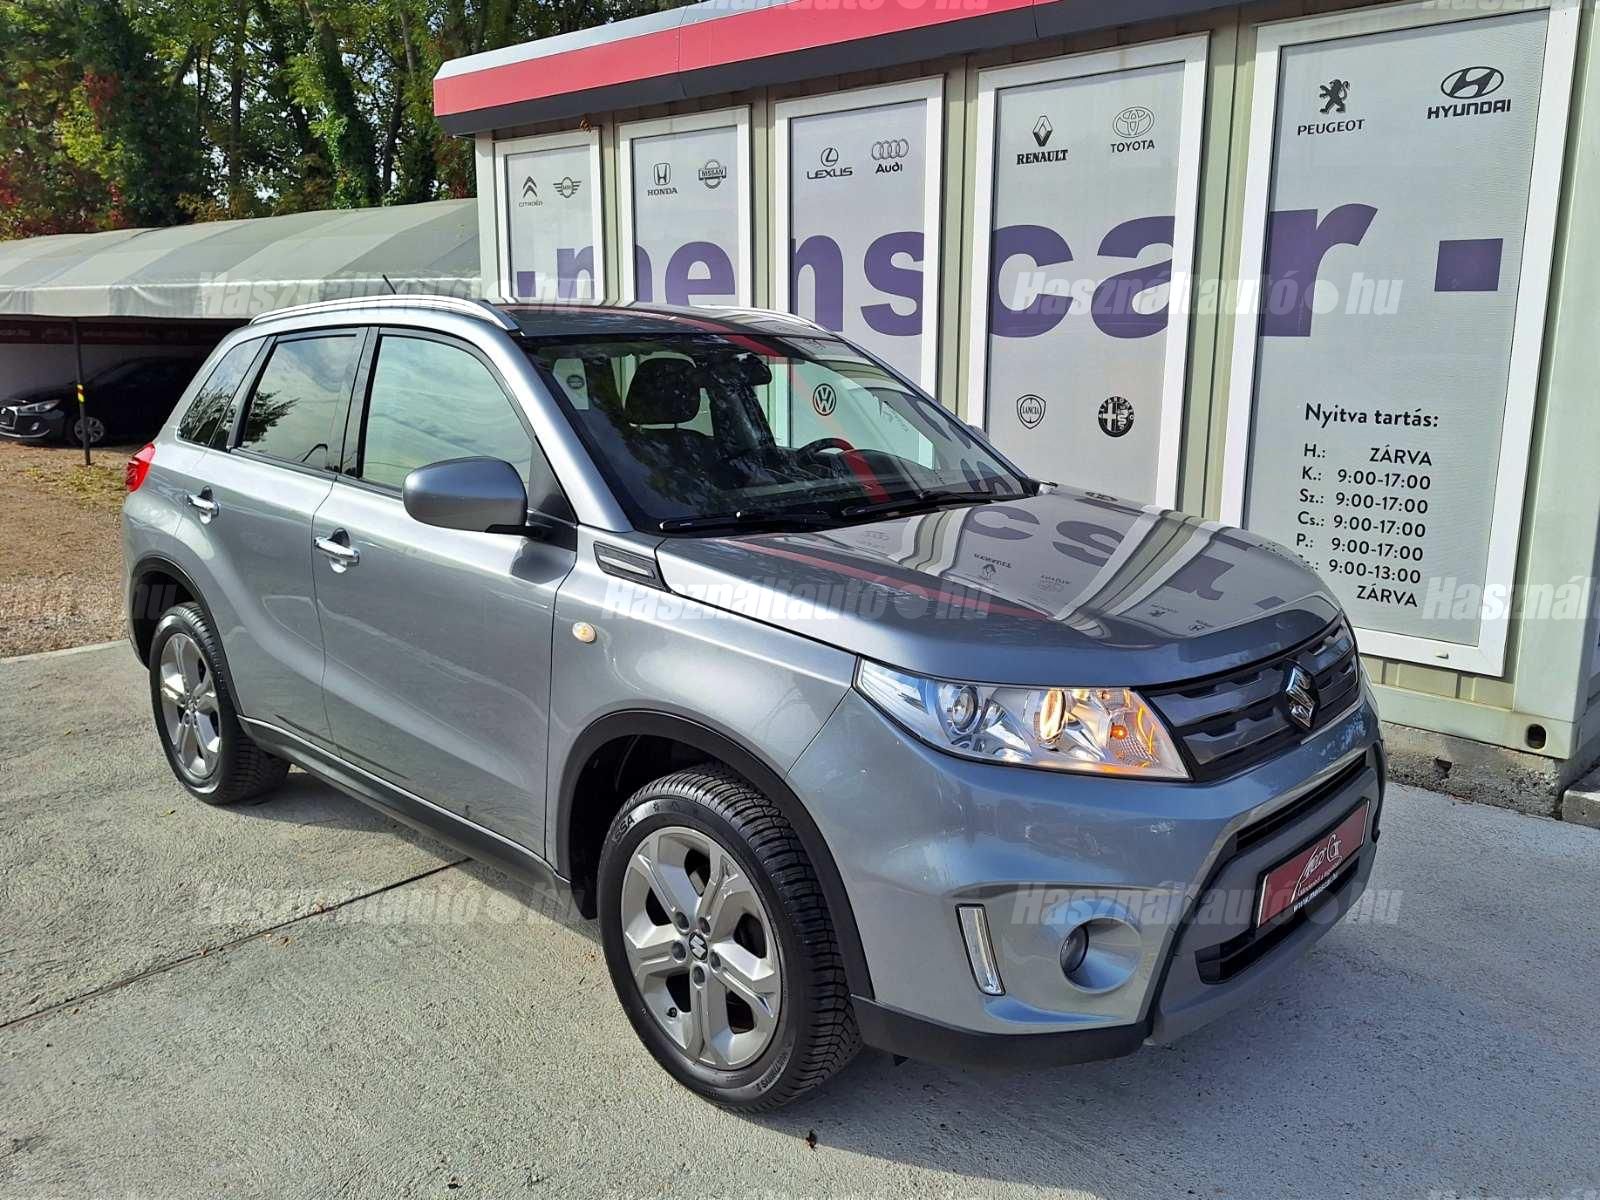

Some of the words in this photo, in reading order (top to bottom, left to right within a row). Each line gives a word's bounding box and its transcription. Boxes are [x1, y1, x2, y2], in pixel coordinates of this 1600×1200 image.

[1427, 98, 1511, 119] HYUNDAI
[1297, 119, 1365, 136] PEUGEOT
[1016, 149, 1068, 165] RENAULT
[1110, 139, 1155, 153] TOYOTA
[701, 166, 725, 178] NISSAN
[807, 166, 853, 180] LEXUS
[875, 162, 903, 175] Audi
[647, 186, 678, 197] HONDA
[1305, 403, 1367, 428] Nyitva
[1374, 408, 1439, 428] tartás:
[1303, 443, 1326, 459] H.:
[1369, 445, 1432, 466] ZÁRVA
[1301, 466, 1322, 481] K.:
[1337, 469, 1431, 490] 9:00-17:00
[1299, 489, 1324, 504] Sz.:
[1335, 492, 1428, 514] 9:00-17:00
[1297, 511, 1325, 527] Cs.:
[1332, 514, 1426, 538] 9:00-17:00
[1296, 533, 1313, 548] P.:
[1331, 537, 1423, 561] 9:00-17:00
[1328, 559, 1421, 583] 9:00-13:00
[1356, 583, 1418, 608] ZÁRVA
